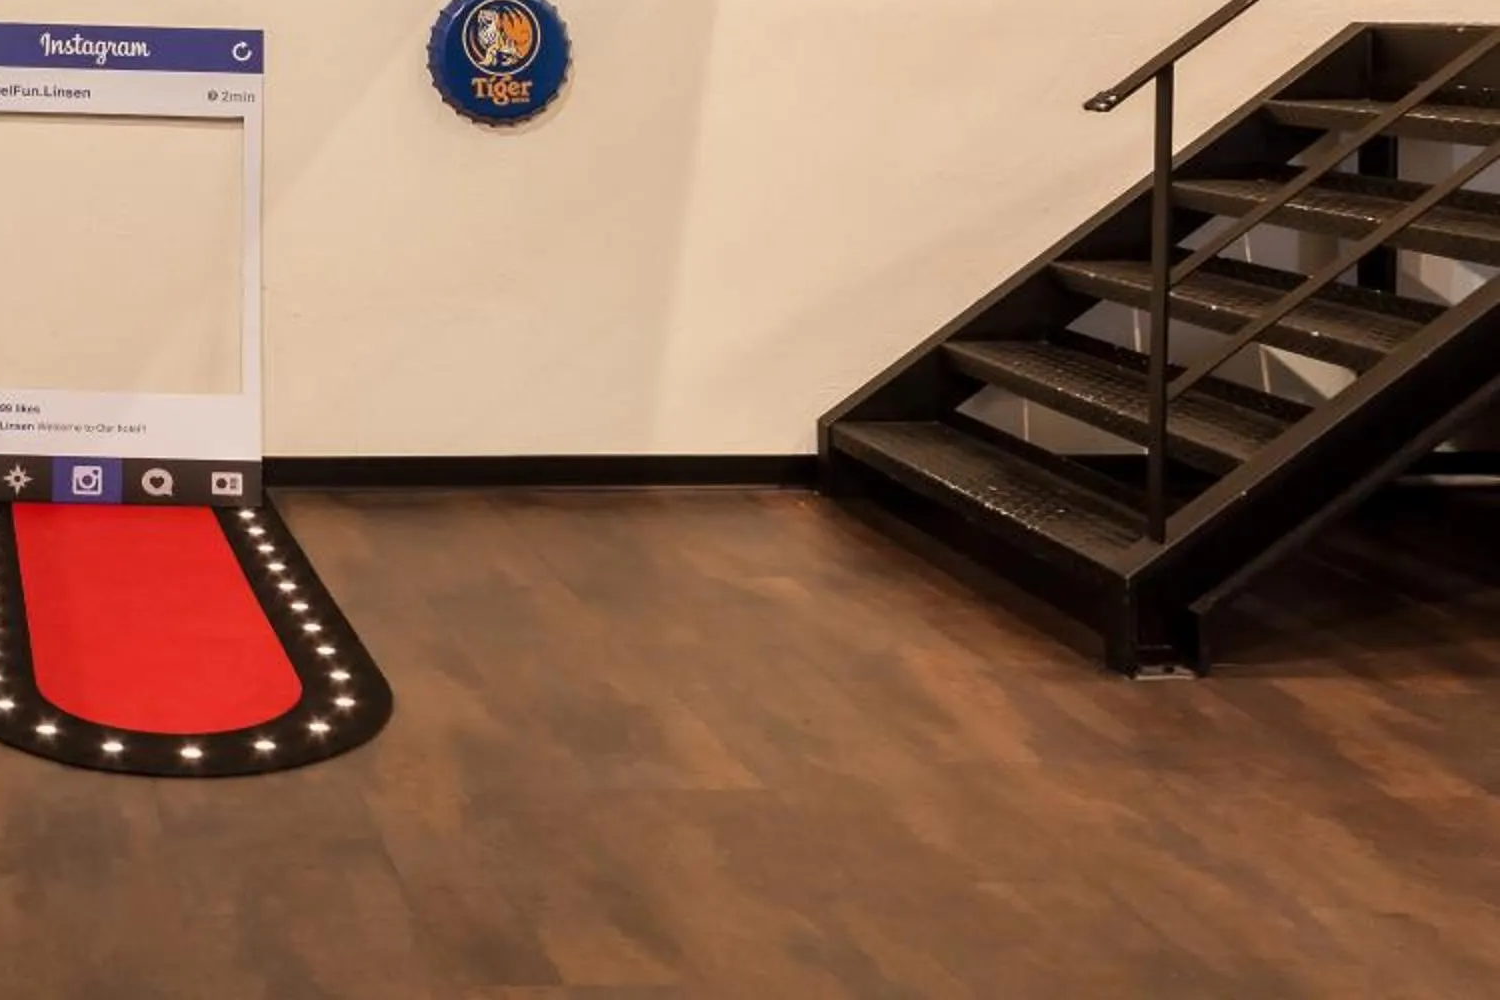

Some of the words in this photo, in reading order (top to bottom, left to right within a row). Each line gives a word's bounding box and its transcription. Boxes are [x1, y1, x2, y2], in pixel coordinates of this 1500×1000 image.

[39, 32, 151, 65] Instagram
[221, 90, 255, 103] 2min
[471, 75, 533, 106] Tiger
